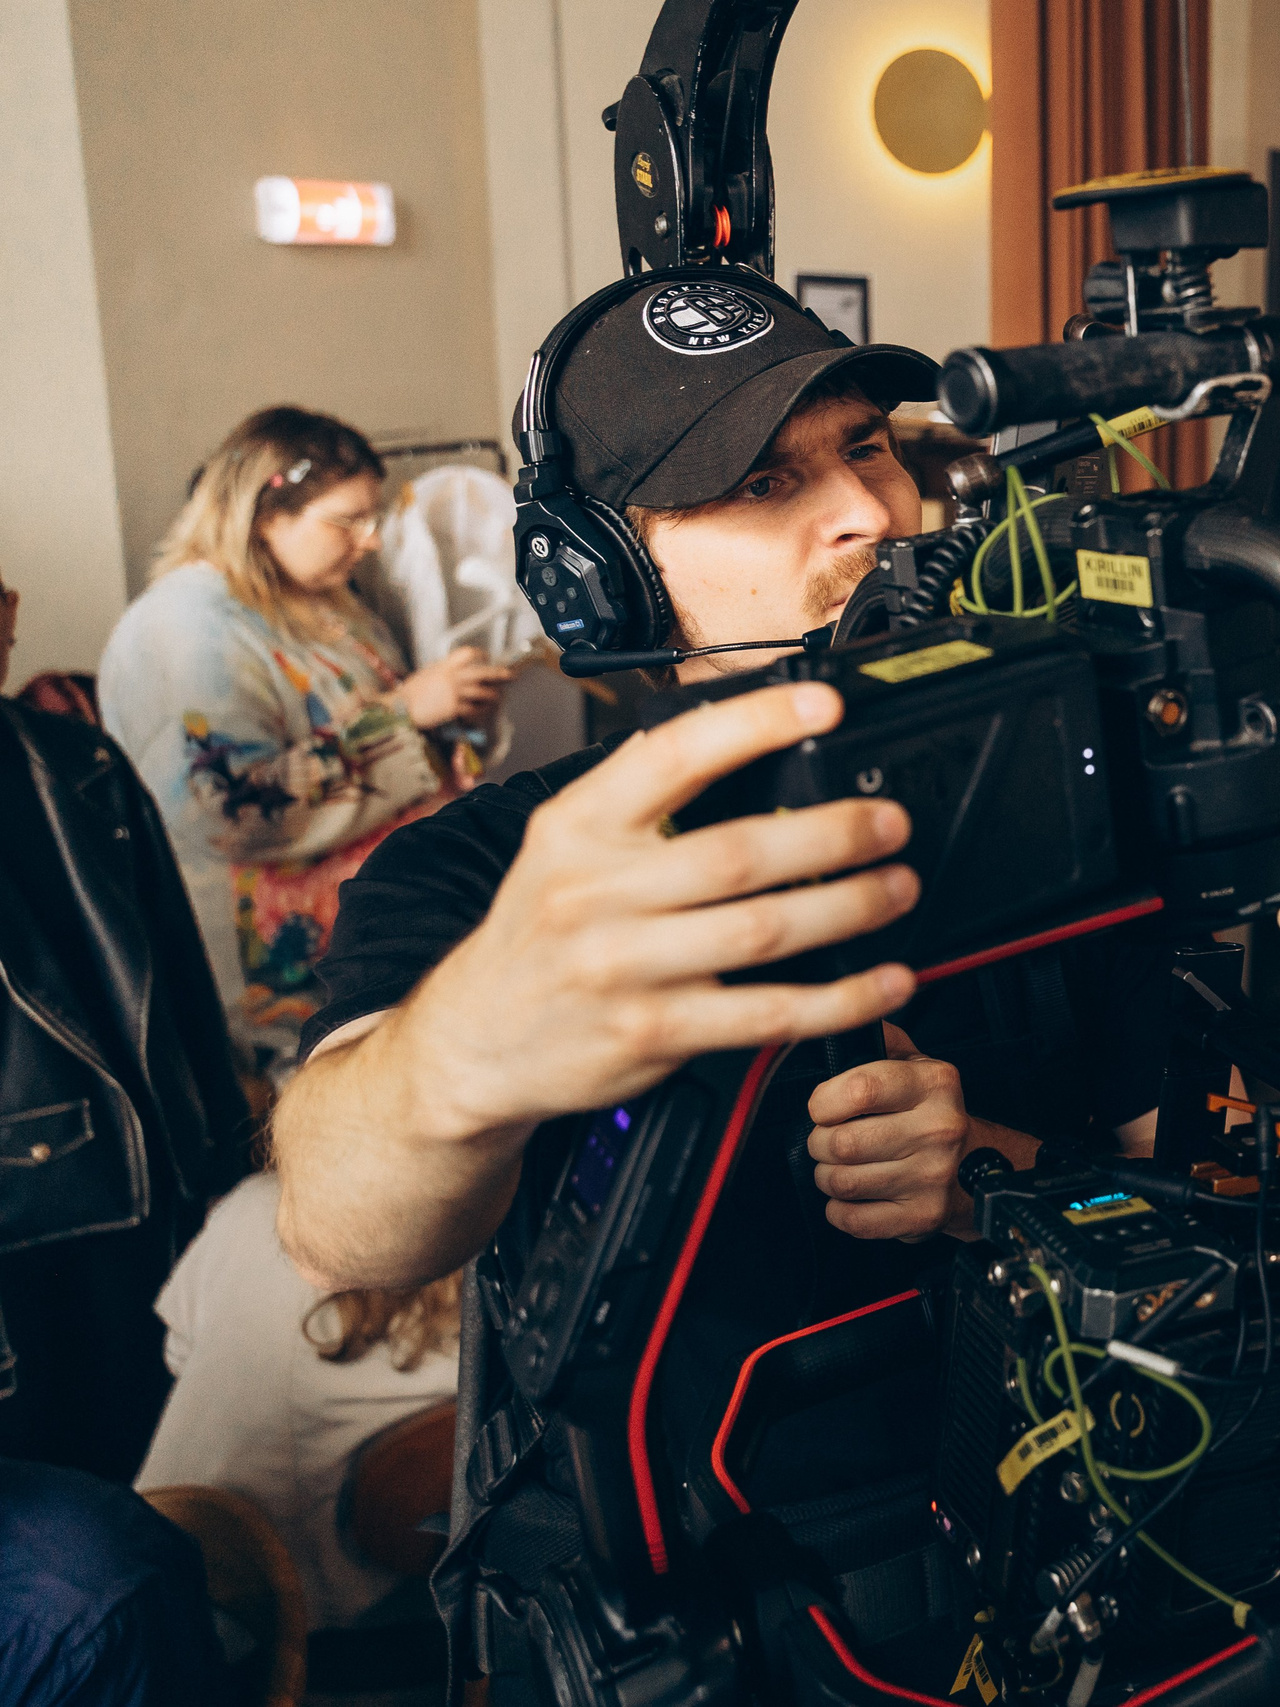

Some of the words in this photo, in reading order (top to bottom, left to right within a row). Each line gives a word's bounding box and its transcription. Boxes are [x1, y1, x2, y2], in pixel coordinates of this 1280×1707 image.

[653, 285, 736, 325] BROOK
[688, 334, 730, 346] NEW
[738, 311, 765, 335] YORK
